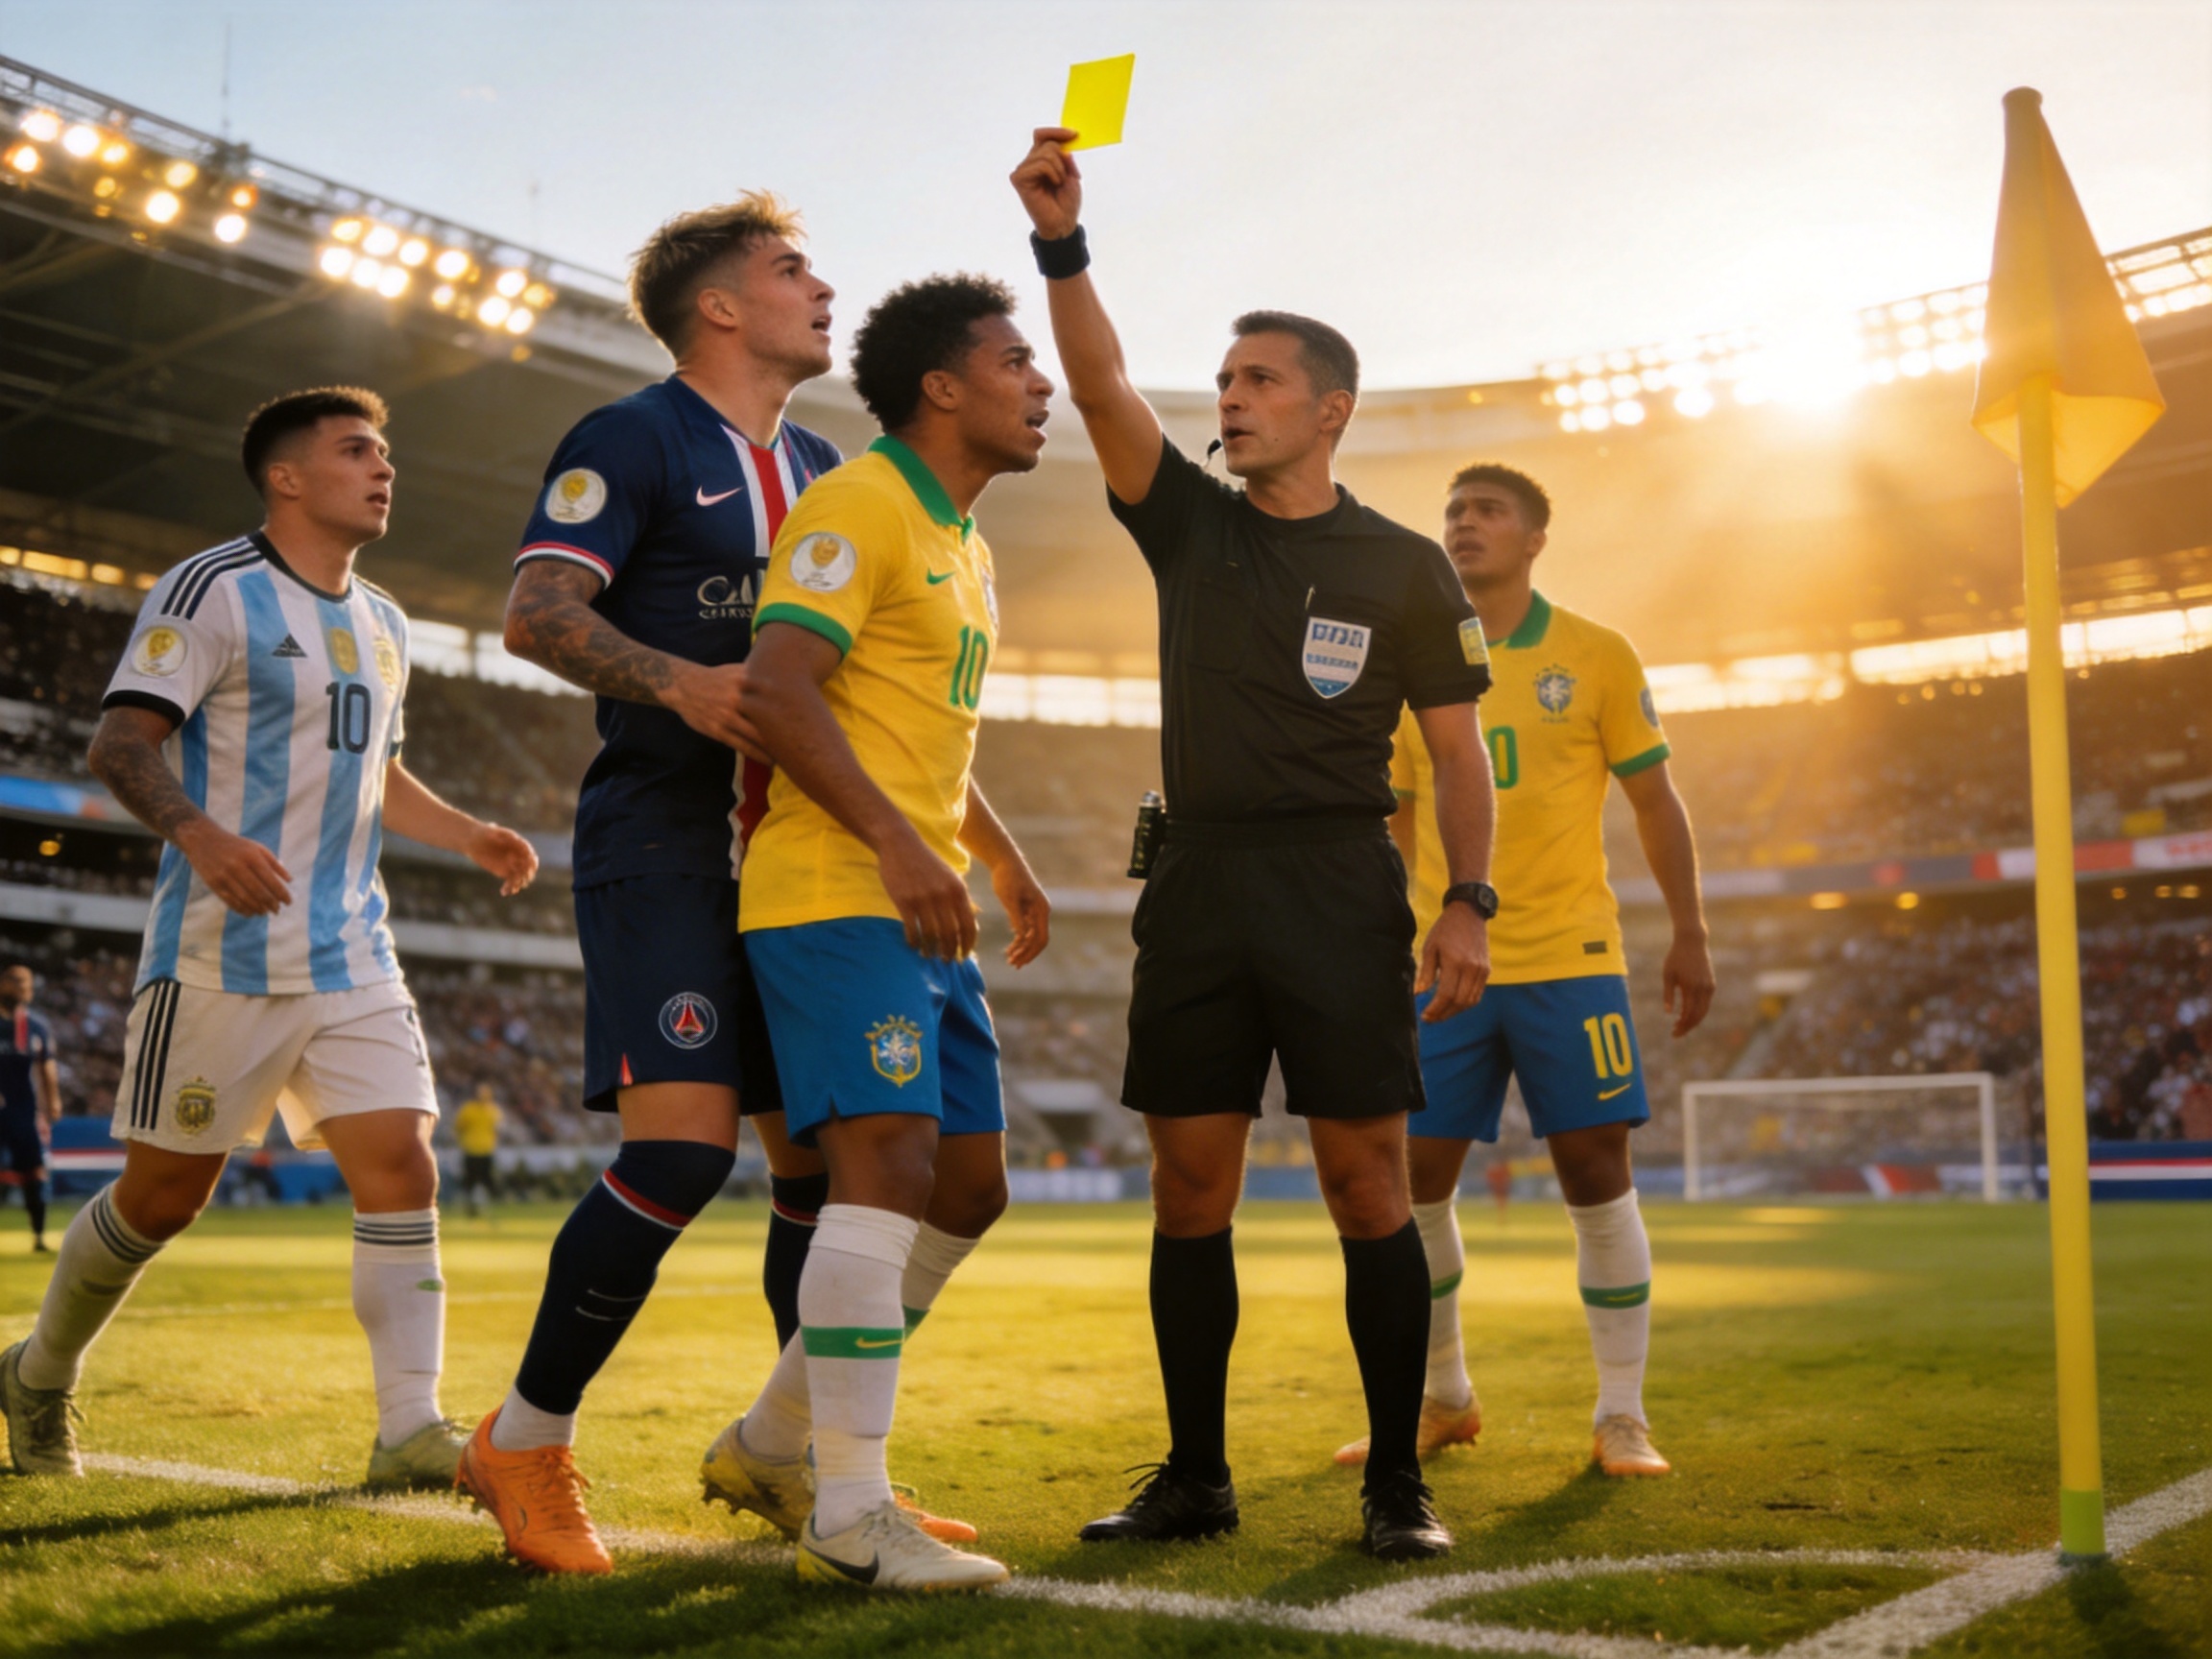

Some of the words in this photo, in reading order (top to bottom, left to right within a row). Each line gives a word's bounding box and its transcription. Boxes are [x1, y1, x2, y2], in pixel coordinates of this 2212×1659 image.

[949, 626, 989, 709] 10
[325, 682, 372, 755] 10
[1487, 725, 1519, 789] 0
[1583, 1013, 1633, 1078] 10
